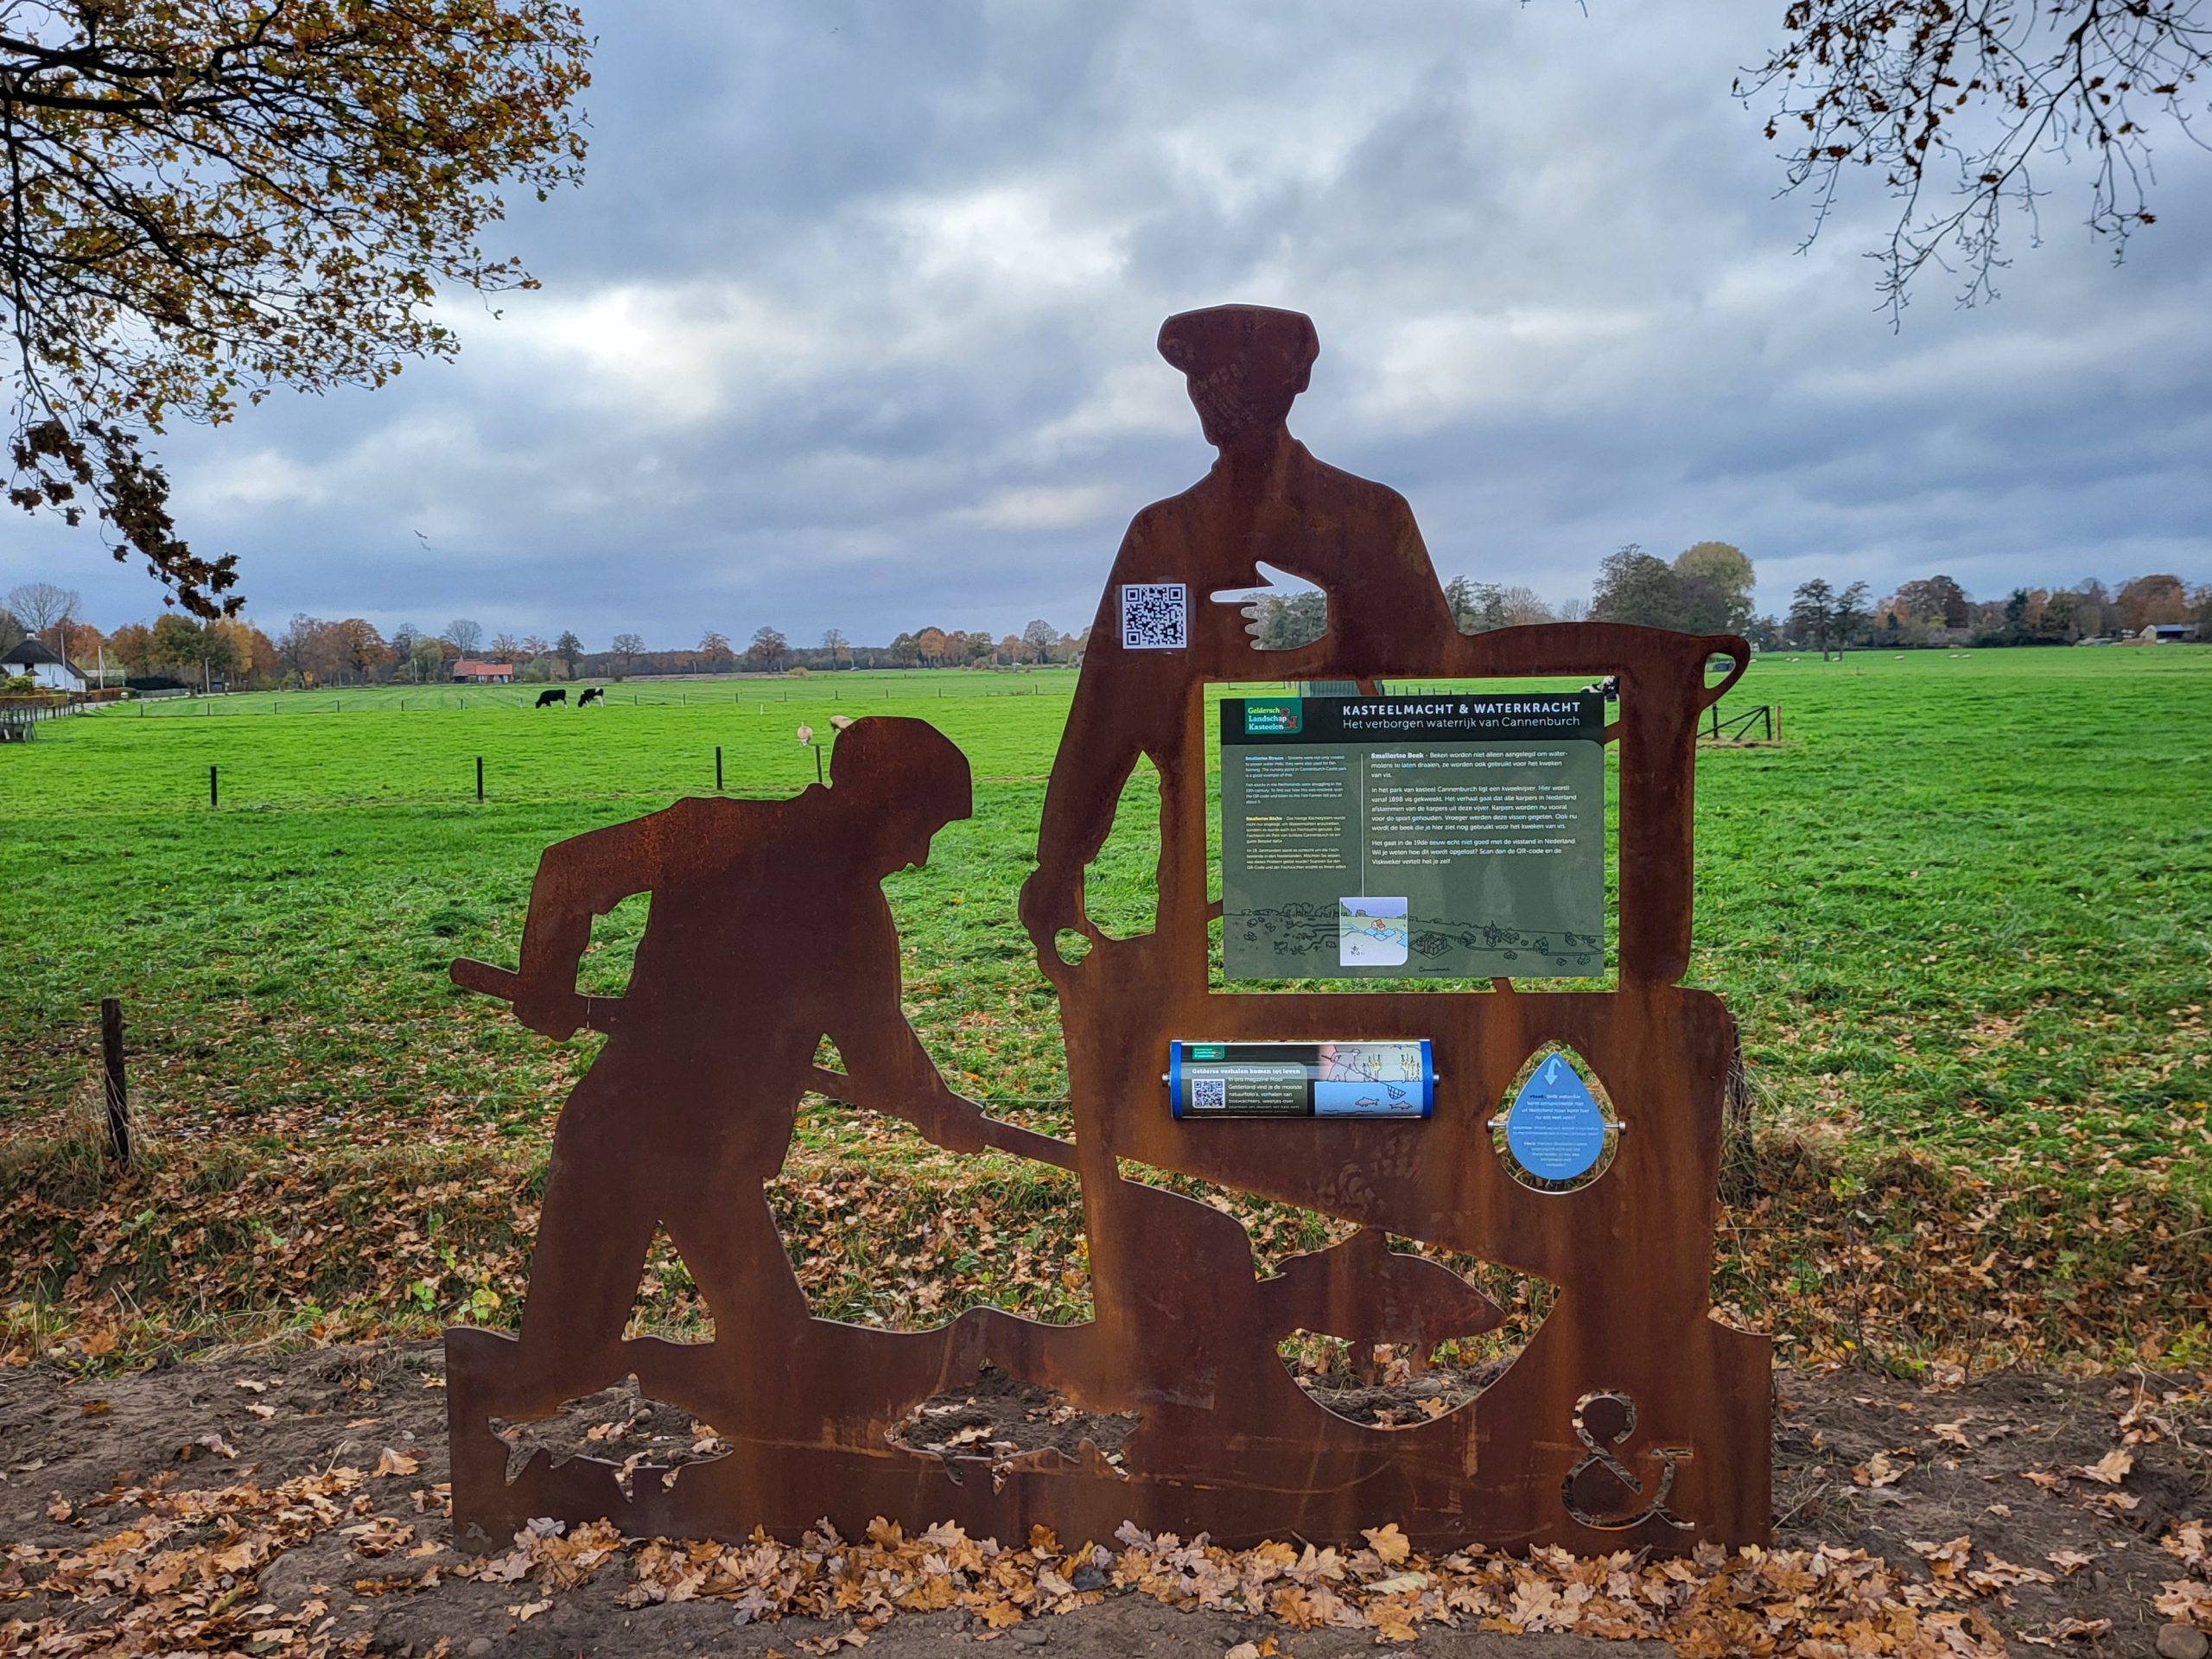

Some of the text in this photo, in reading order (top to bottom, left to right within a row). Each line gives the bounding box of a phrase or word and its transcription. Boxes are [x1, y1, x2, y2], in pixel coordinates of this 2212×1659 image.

[1343, 702, 1580, 715] KASTEELMACHT & WATERKRACHT
[1343, 718, 1363, 728] Het
[1365, 717, 1423, 731] verborgen
[1426, 716, 1476, 730] waterrijk
[1501, 715, 1580, 726] Cannenburch
[1504, 750, 1535, 759] aangelegd
[1486, 760, 1511, 769] gebruikt
[1389, 786, 1402, 795] park
[1444, 814, 1468, 823] Vroeger
[1560, 1389, 1695, 1532] &
